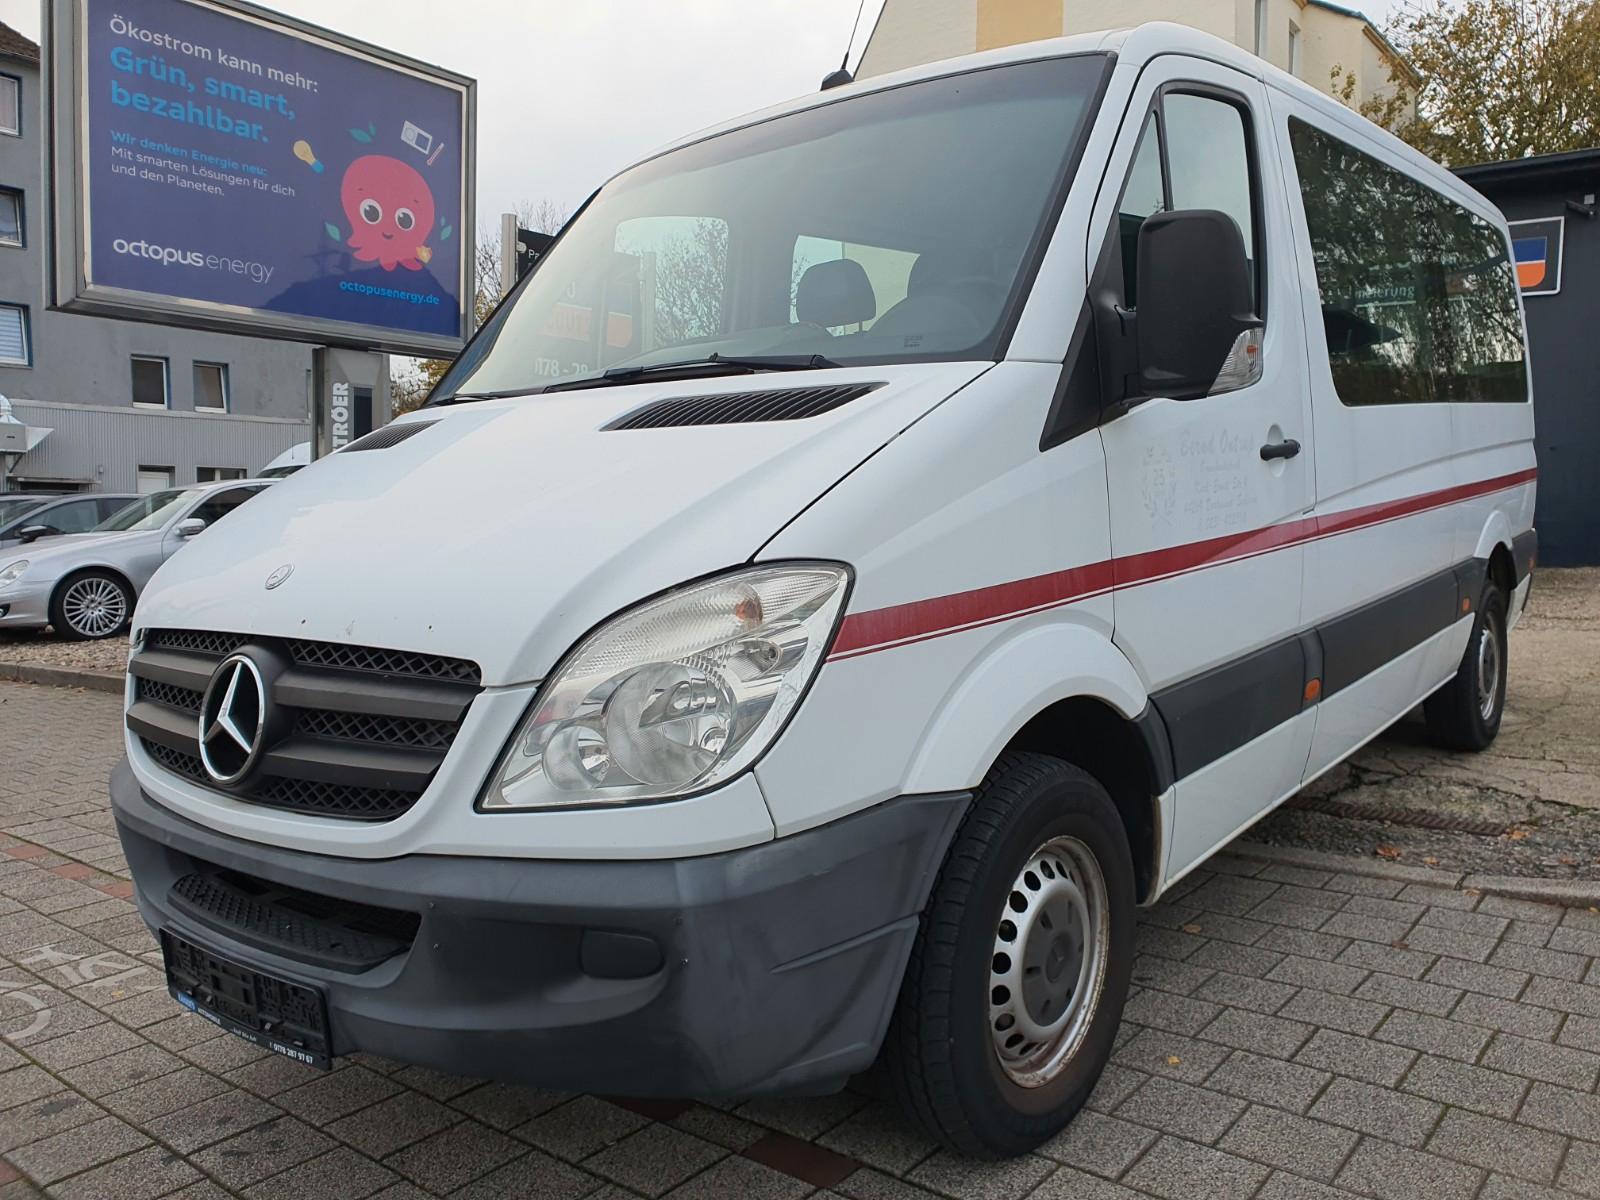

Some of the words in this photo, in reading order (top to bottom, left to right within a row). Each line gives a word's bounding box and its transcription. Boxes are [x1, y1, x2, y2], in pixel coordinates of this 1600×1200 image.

[110, 14, 211, 61] Ökostrom
[218, 48, 262, 76] kann
[268, 67, 318, 93] mehr:
[111, 46, 196, 93] Grün,
[205, 77, 296, 121] smart,
[111, 80, 269, 142] bezahlbar.
[111, 130, 136, 145] Wir
[140, 138, 188, 158] denken
[192, 149, 241, 169] Energie
[242, 163, 268, 177] neu:
[111, 146, 133, 160] Mit
[136, 153, 188, 173] smarten
[192, 164, 250, 186] Lösungen
[253, 178, 269, 191] für
[271, 183, 295, 197] dich
[111, 163, 136, 176] und
[139, 168, 164, 183] den
[167, 174, 225, 196] Planeten.
[339, 281, 440, 304] octopusenergy.de
[331, 382, 349, 452] TRÖER
